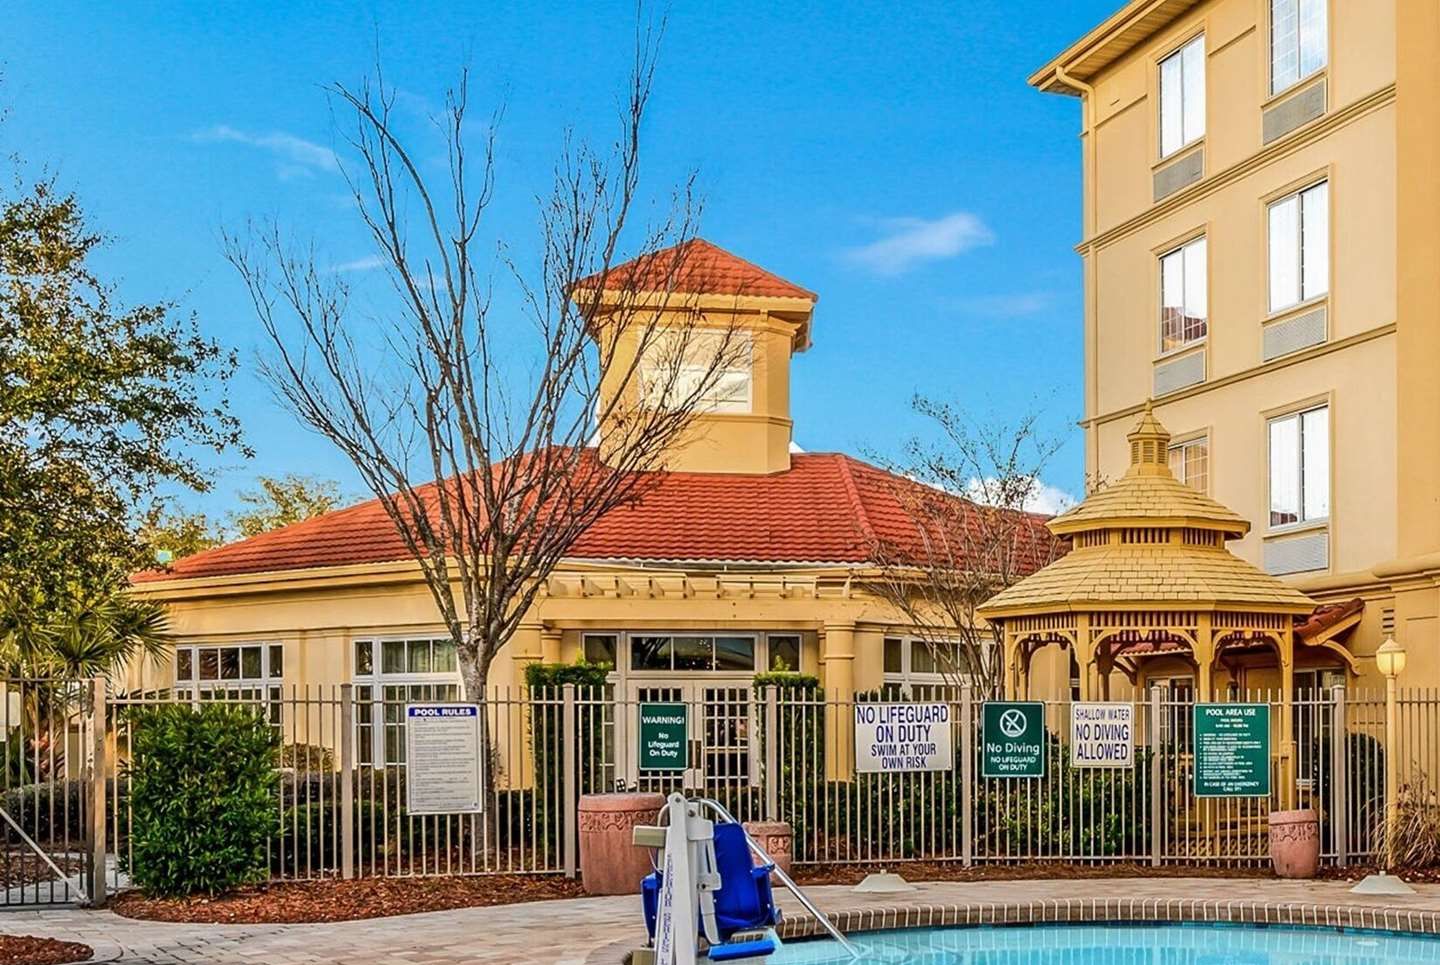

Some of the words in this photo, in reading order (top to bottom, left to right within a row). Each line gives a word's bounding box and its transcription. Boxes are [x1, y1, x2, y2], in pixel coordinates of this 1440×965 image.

[414, 708, 440, 716] POOL
[441, 708, 471, 716] RULES
[856, 706, 876, 724] NO
[879, 705, 949, 724] LIFEGUARD
[1075, 709, 1106, 721] SHALLOW
[1108, 708, 1130, 720] WATER
[1206, 708, 1223, 716] POOL
[1225, 708, 1243, 716] AREA
[1243, 708, 1256, 716] USE
[642, 716, 685, 724] WARNING!
[876, 725, 894, 743] ON
[898, 724, 931, 742] DUTY
[1076, 724, 1090, 740] NO
[1094, 724, 1129, 741] DIVING
[648, 741, 680, 749] Lifeguard
[871, 744, 897, 757] SWIM
[900, 744, 910, 756] AT
[913, 743, 937, 756] YOUR
[986, 743, 1002, 753] No
[1005, 742, 1040, 756] Diving
[1077, 743, 1128, 760] ALLOWED
[649, 749, 660, 757] On
[661, 749, 678, 758] Duty
[1002, 756, 1037, 764] LIFEGUARD
[882, 757, 903, 769] OWN
[906, 756, 927, 769] RISK
